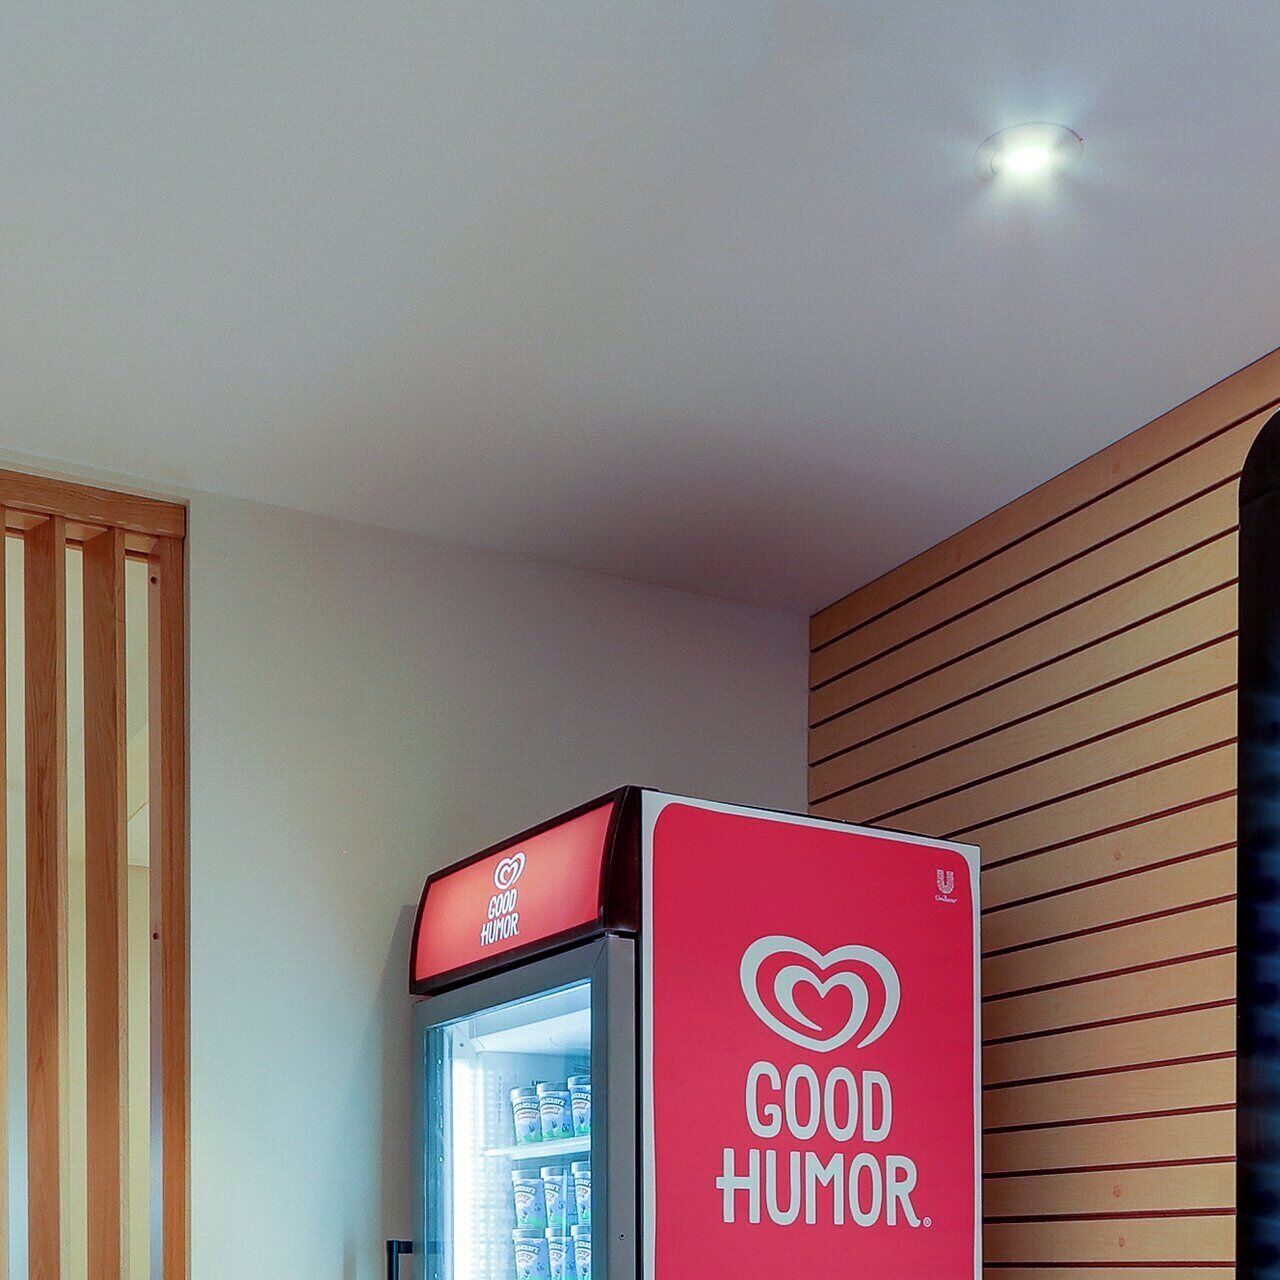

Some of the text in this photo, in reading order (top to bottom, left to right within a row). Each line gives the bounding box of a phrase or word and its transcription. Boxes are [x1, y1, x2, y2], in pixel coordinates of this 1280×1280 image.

[480, 912, 519, 947] HUMOR
[488, 888, 519, 920] GOOD
[745, 1061, 894, 1144] GOOD
[716, 1148, 923, 1228] HUMOR
